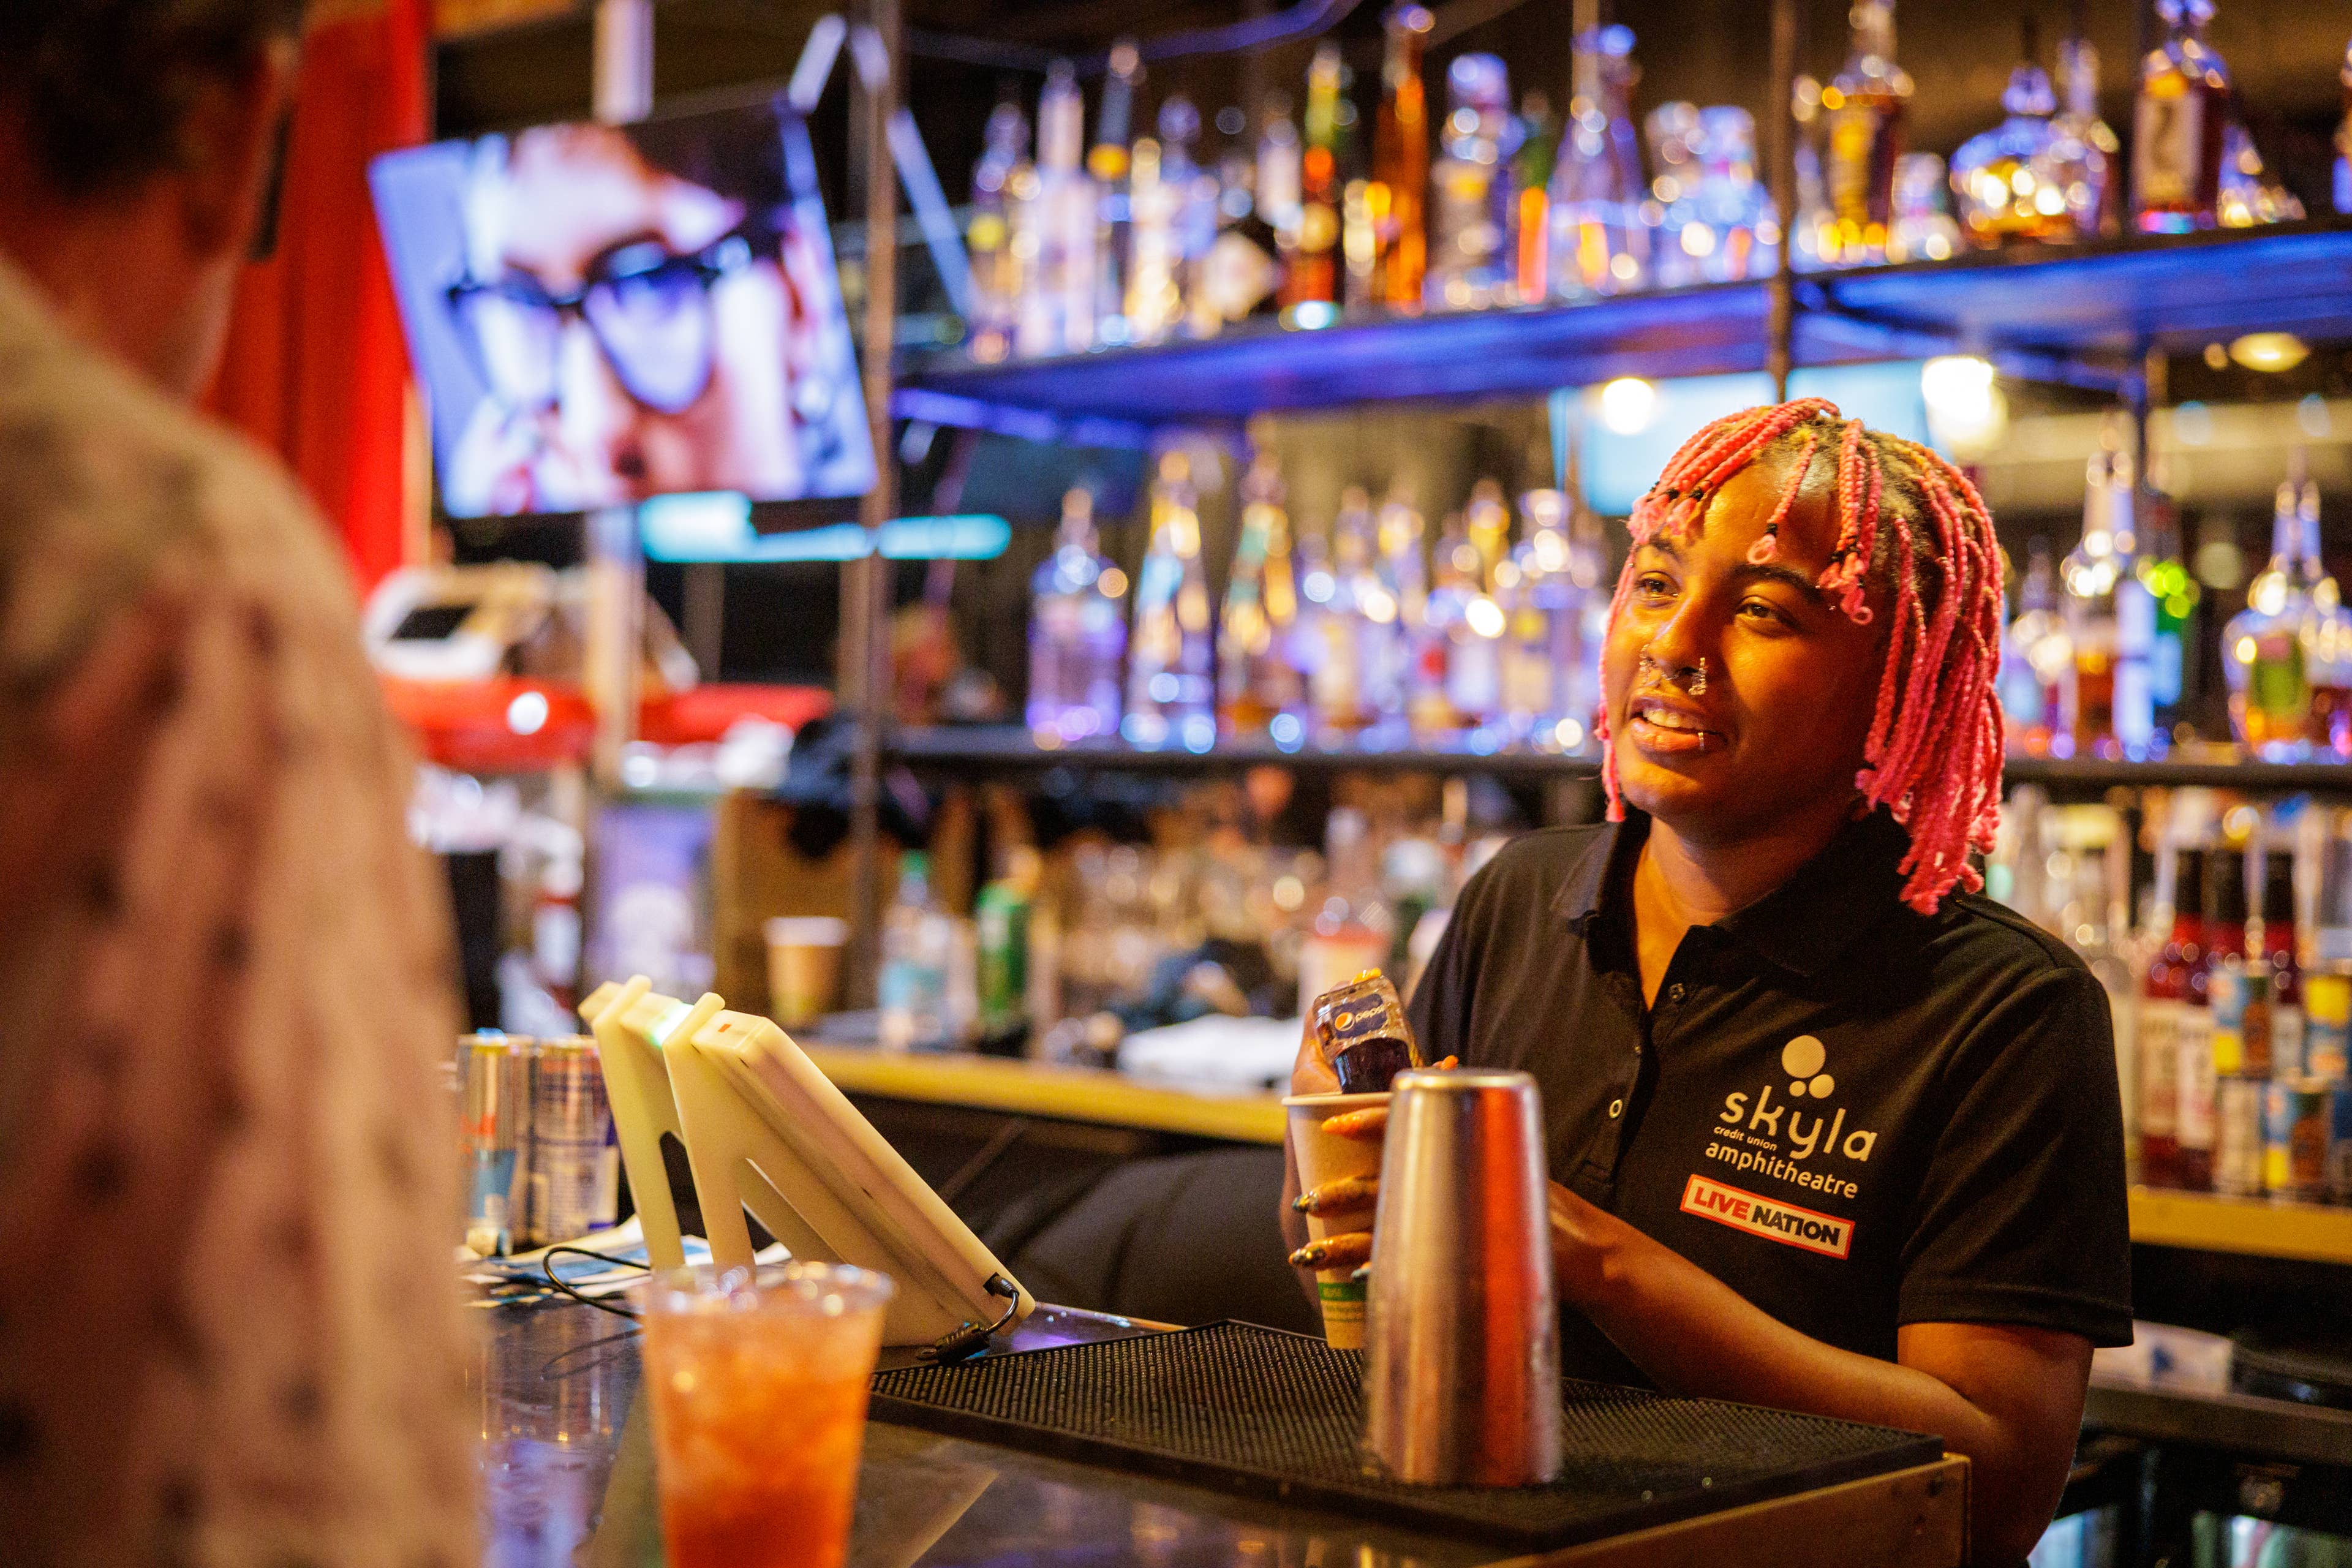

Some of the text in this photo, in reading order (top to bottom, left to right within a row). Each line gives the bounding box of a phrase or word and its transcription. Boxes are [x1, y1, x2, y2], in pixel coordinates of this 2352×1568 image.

[1714, 1126, 1777, 1152] credit union
[1719, 1085, 1877, 1161] skyla
[1705, 1142, 1858, 1199] amphitheatre
[1693, 1186, 1841, 1246] LIVE NATION
